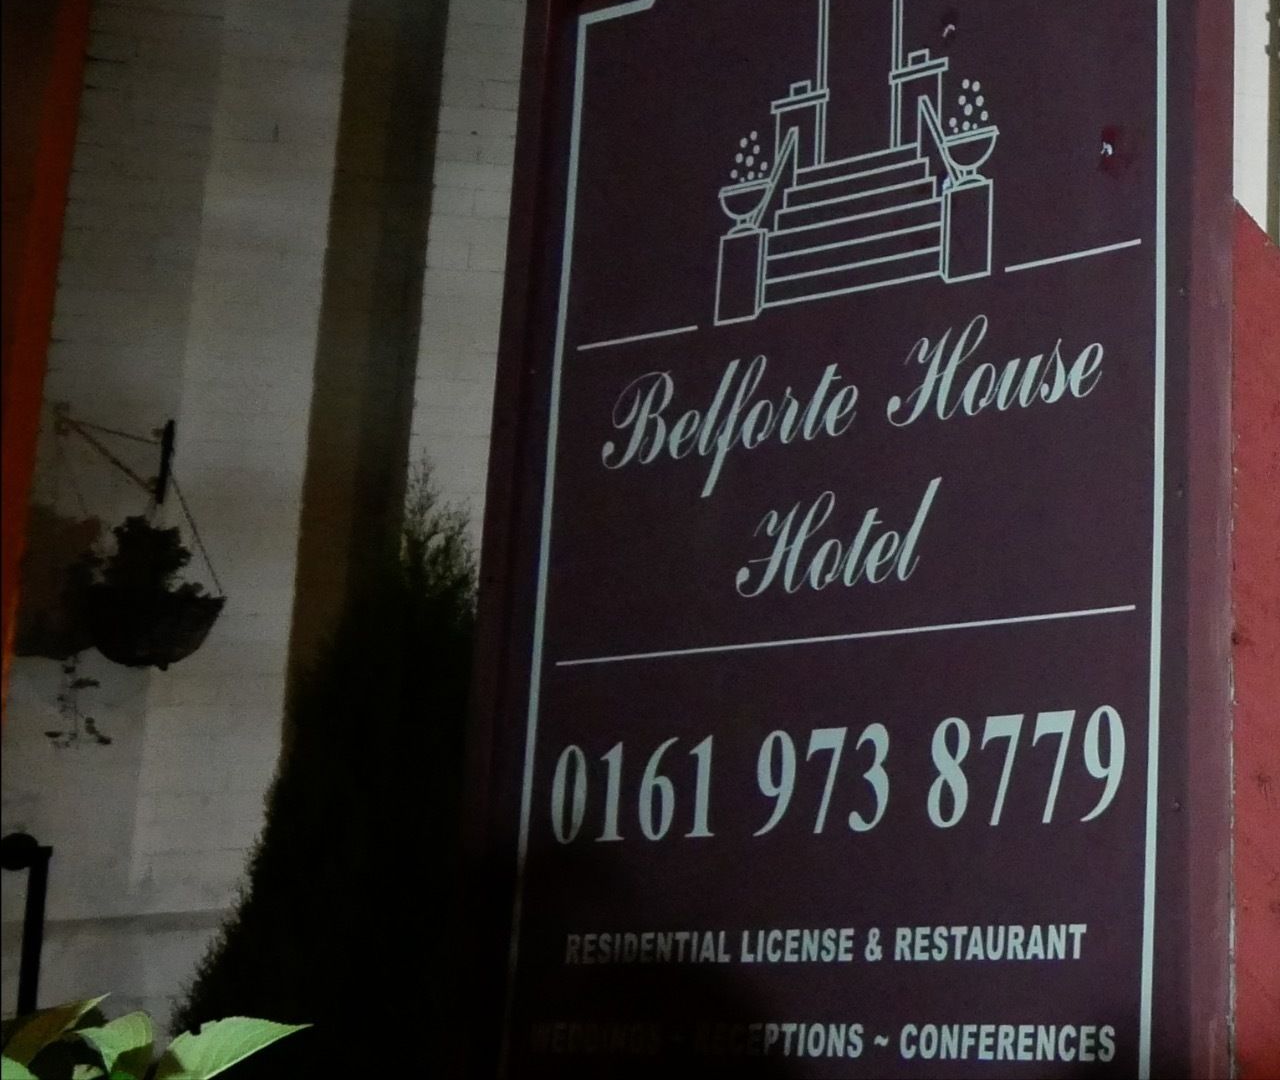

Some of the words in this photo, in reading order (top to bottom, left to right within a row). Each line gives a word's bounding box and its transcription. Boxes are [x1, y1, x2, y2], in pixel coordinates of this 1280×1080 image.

[602, 354, 859, 498] Belforte
[886, 314, 1104, 427] House
[735, 476, 942, 598] Hotel
[550, 734, 715, 845] 0161
[752, 722, 890, 838] 973
[926, 704, 1127, 830] 8779
[565, 930, 731, 964] RESIDENTIAL
[740, 928, 855, 963] LICENSE
[864, 926, 883, 962] &
[894, 923, 1087, 961] RESTAURANT
[900, 1023, 1116, 1062] CONFERENCES
